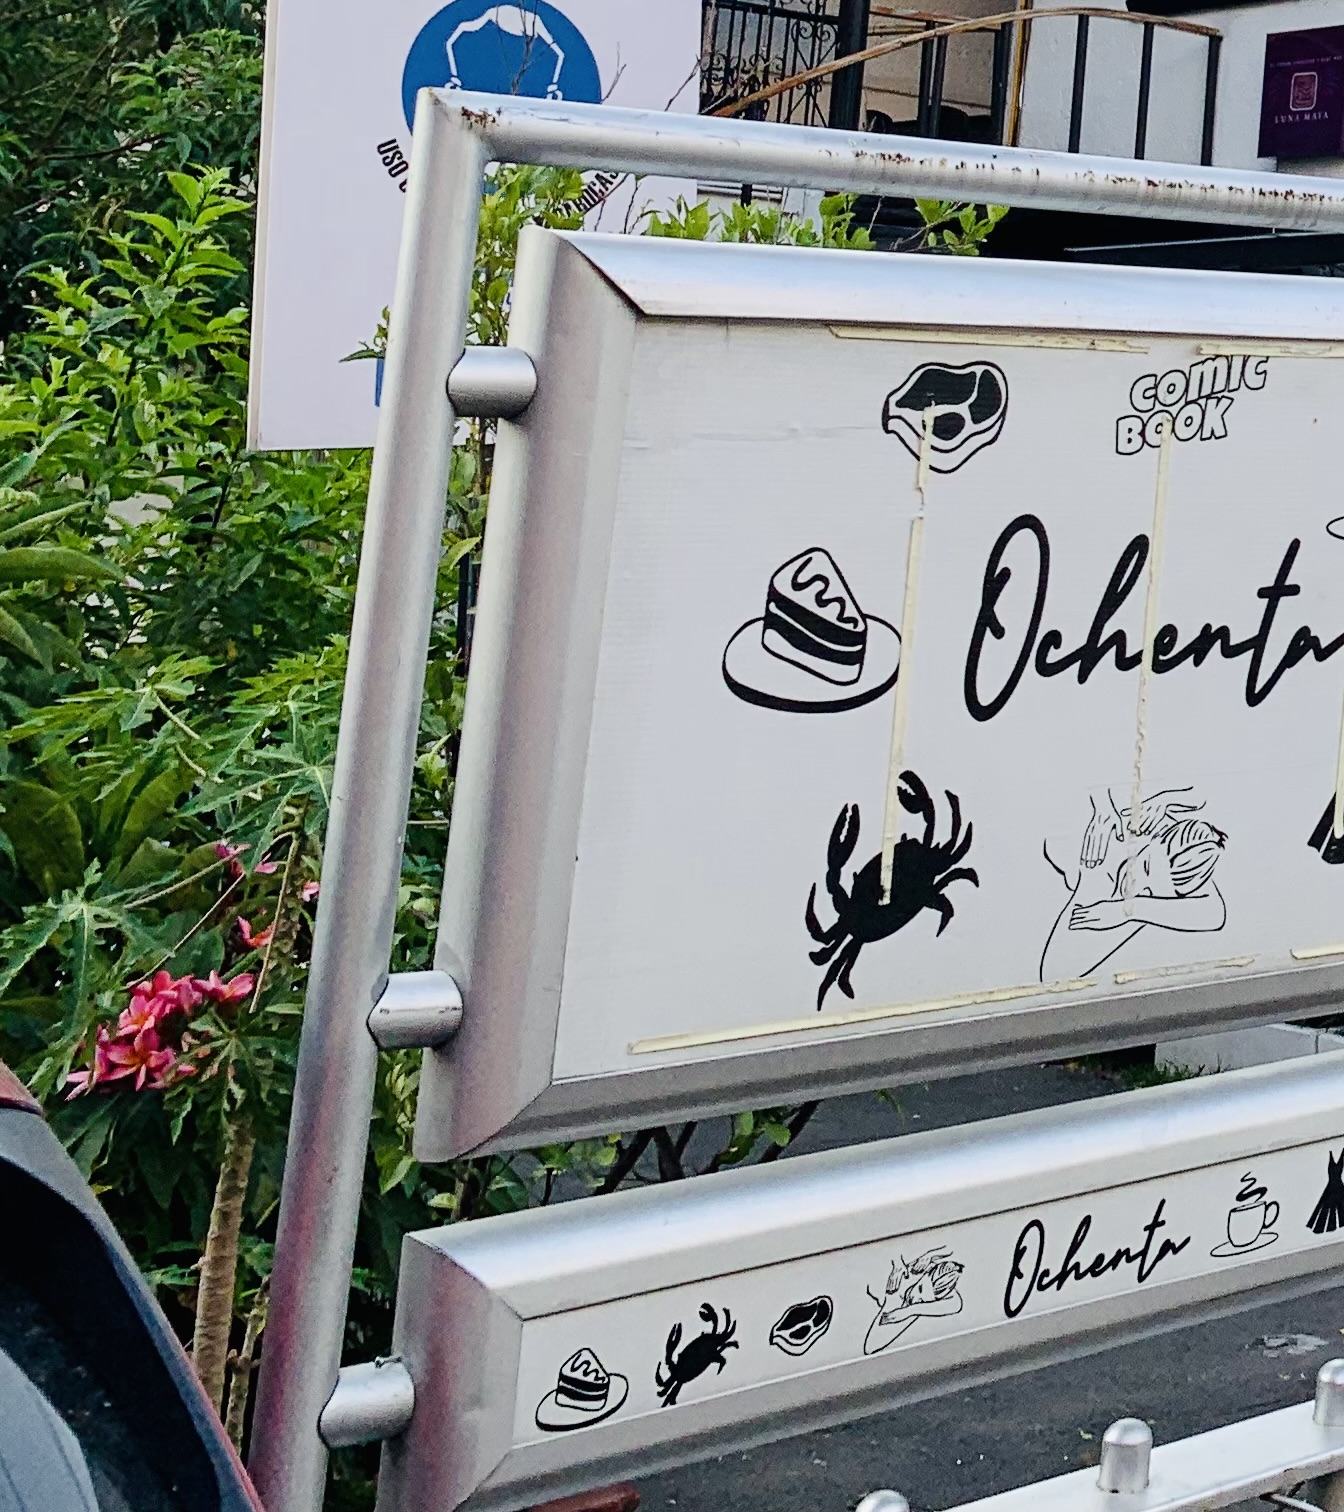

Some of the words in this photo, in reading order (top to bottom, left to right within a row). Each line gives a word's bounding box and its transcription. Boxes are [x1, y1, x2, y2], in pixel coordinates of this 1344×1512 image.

[376, 137, 409, 178] USO
[1129, 354, 1270, 414] COMIC
[1115, 395, 1235, 456] BOOK
[1003, 1198, 1192, 1319] Ochenta
